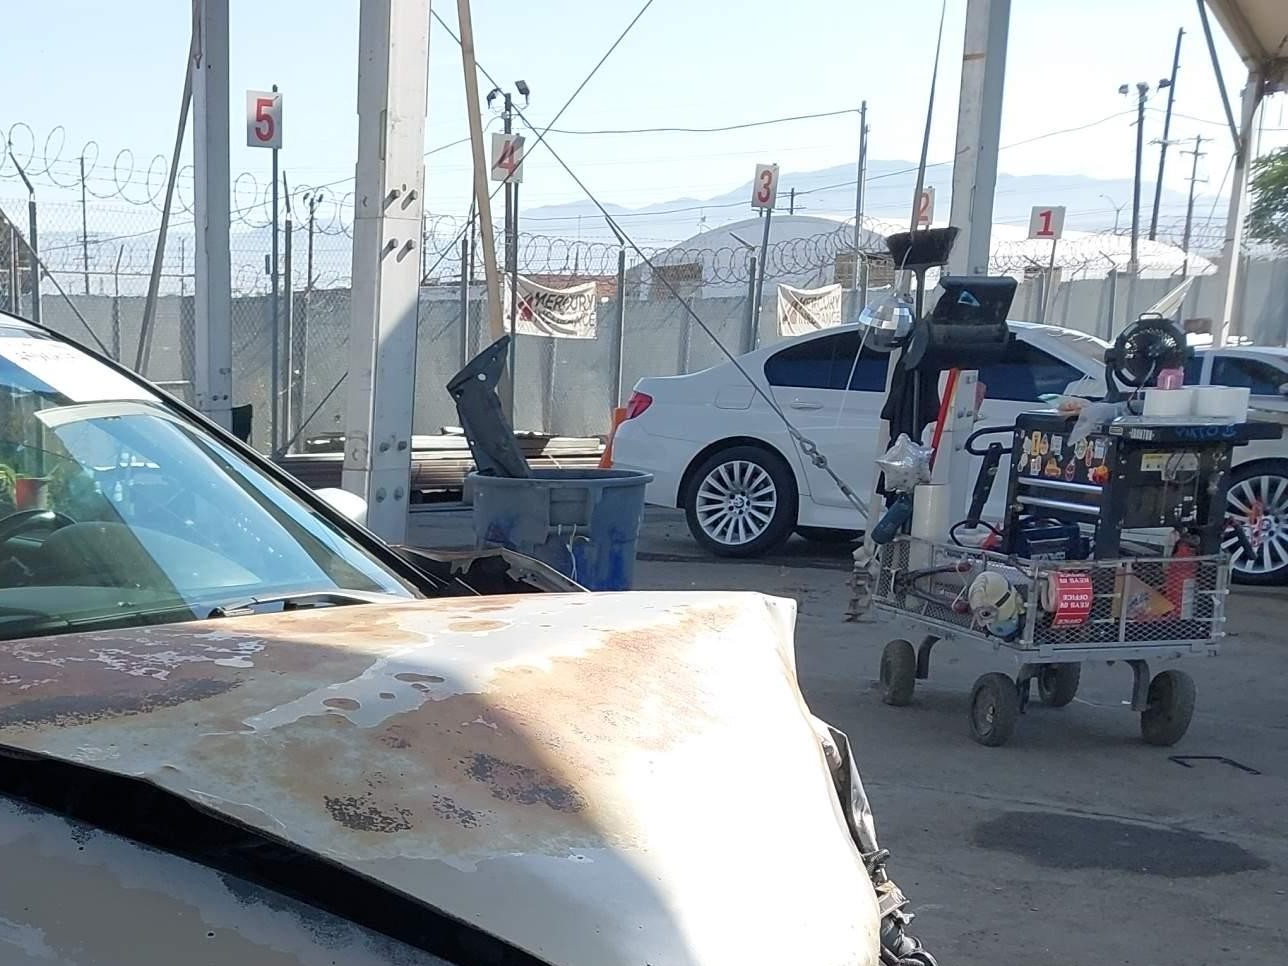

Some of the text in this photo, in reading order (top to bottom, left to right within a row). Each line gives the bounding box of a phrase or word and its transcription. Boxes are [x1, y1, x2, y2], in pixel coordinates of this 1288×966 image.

[255, 98, 274, 142] 5
[498, 141, 516, 176] 4
[757, 170, 772, 203] 3
[1037, 210, 1054, 236] 1
